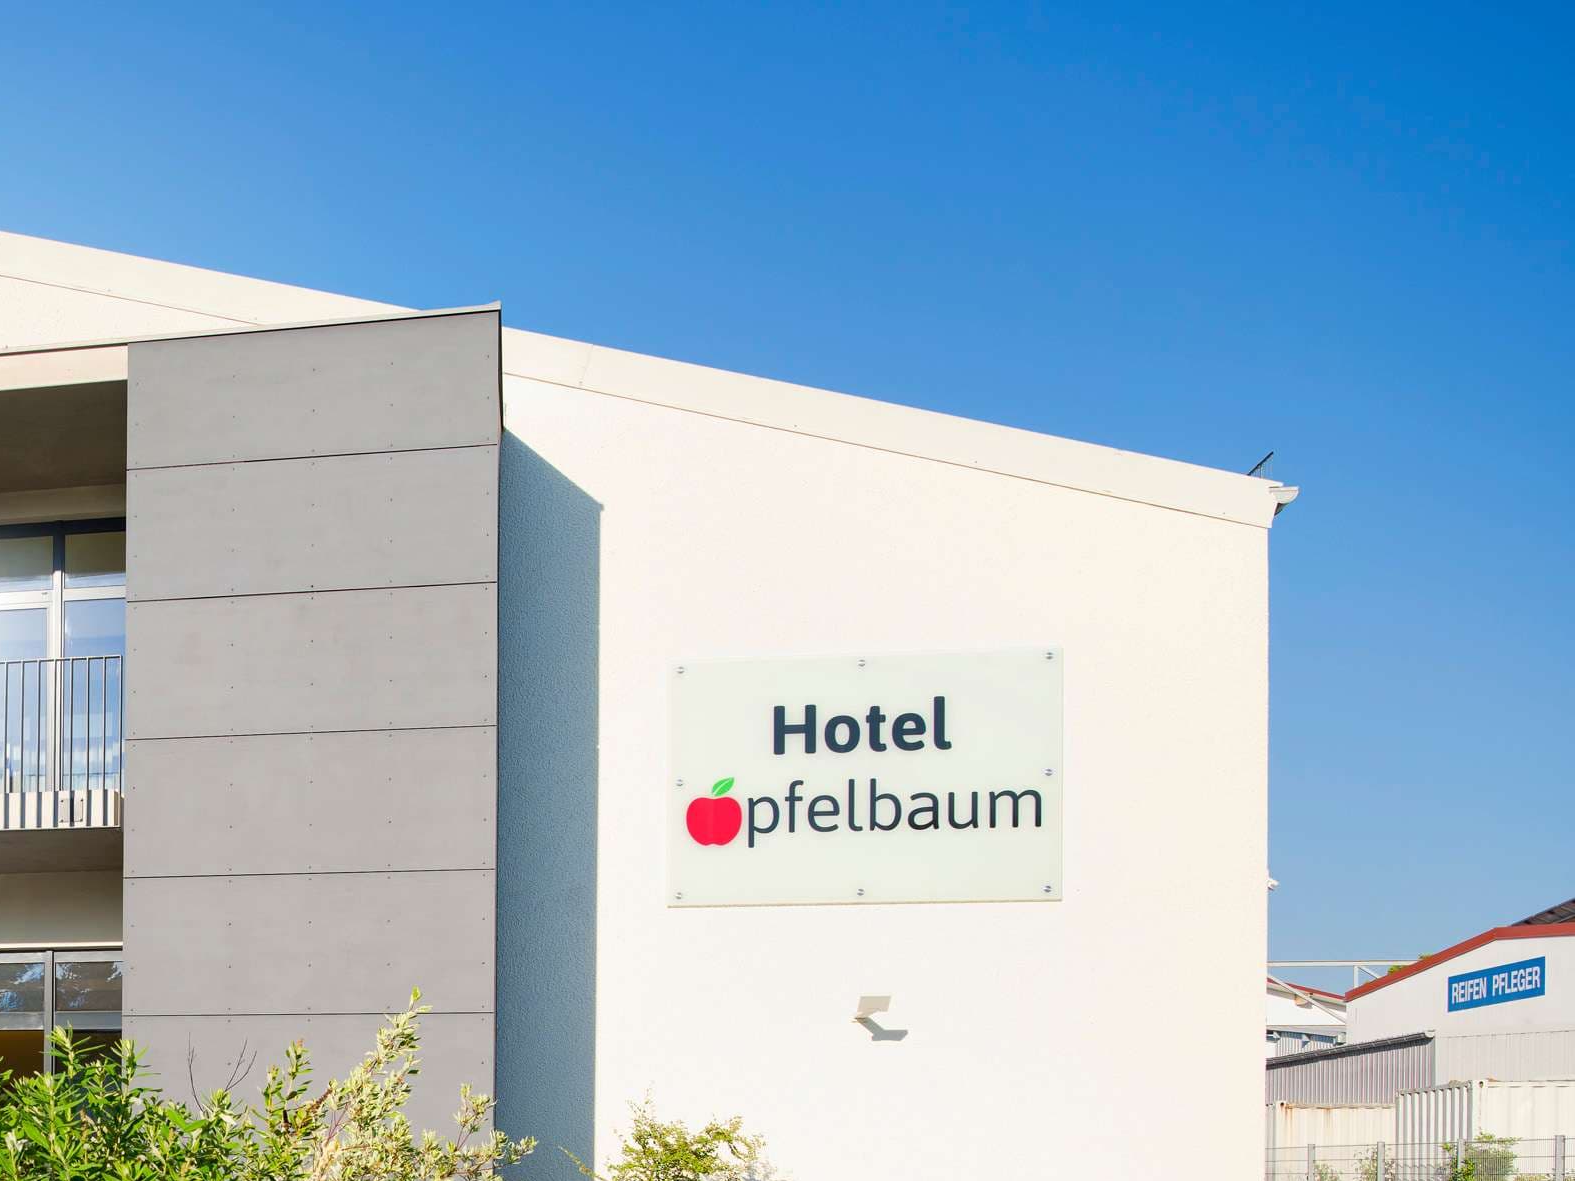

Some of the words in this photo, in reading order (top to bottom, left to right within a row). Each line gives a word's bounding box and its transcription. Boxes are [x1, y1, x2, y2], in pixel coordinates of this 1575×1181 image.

[773, 696, 952, 755] Hotel
[1451, 977, 1487, 1004] REIFEN
[1492, 966, 1540, 996] PFLEGER
